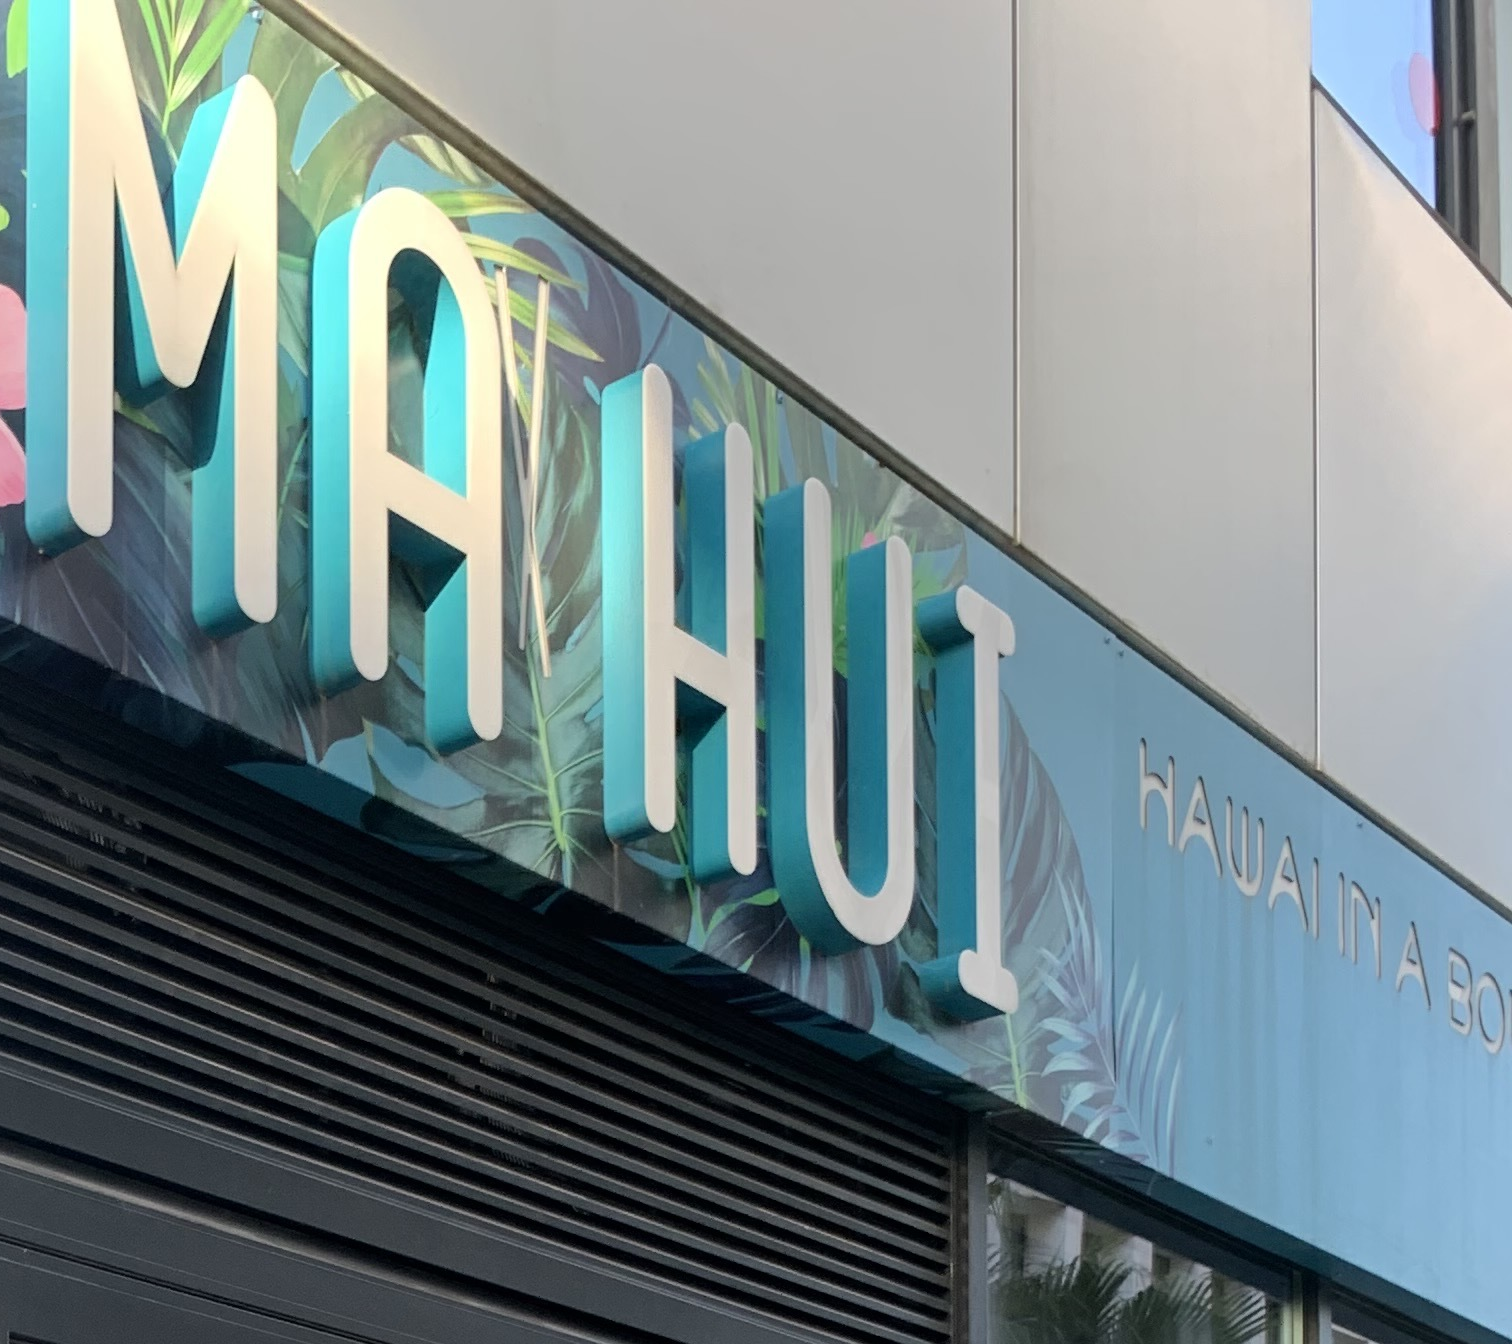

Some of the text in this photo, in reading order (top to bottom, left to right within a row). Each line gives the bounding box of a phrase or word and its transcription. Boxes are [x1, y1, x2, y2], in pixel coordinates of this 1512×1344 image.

[1138, 737, 1512, 1056] HAWAI IN A BO
